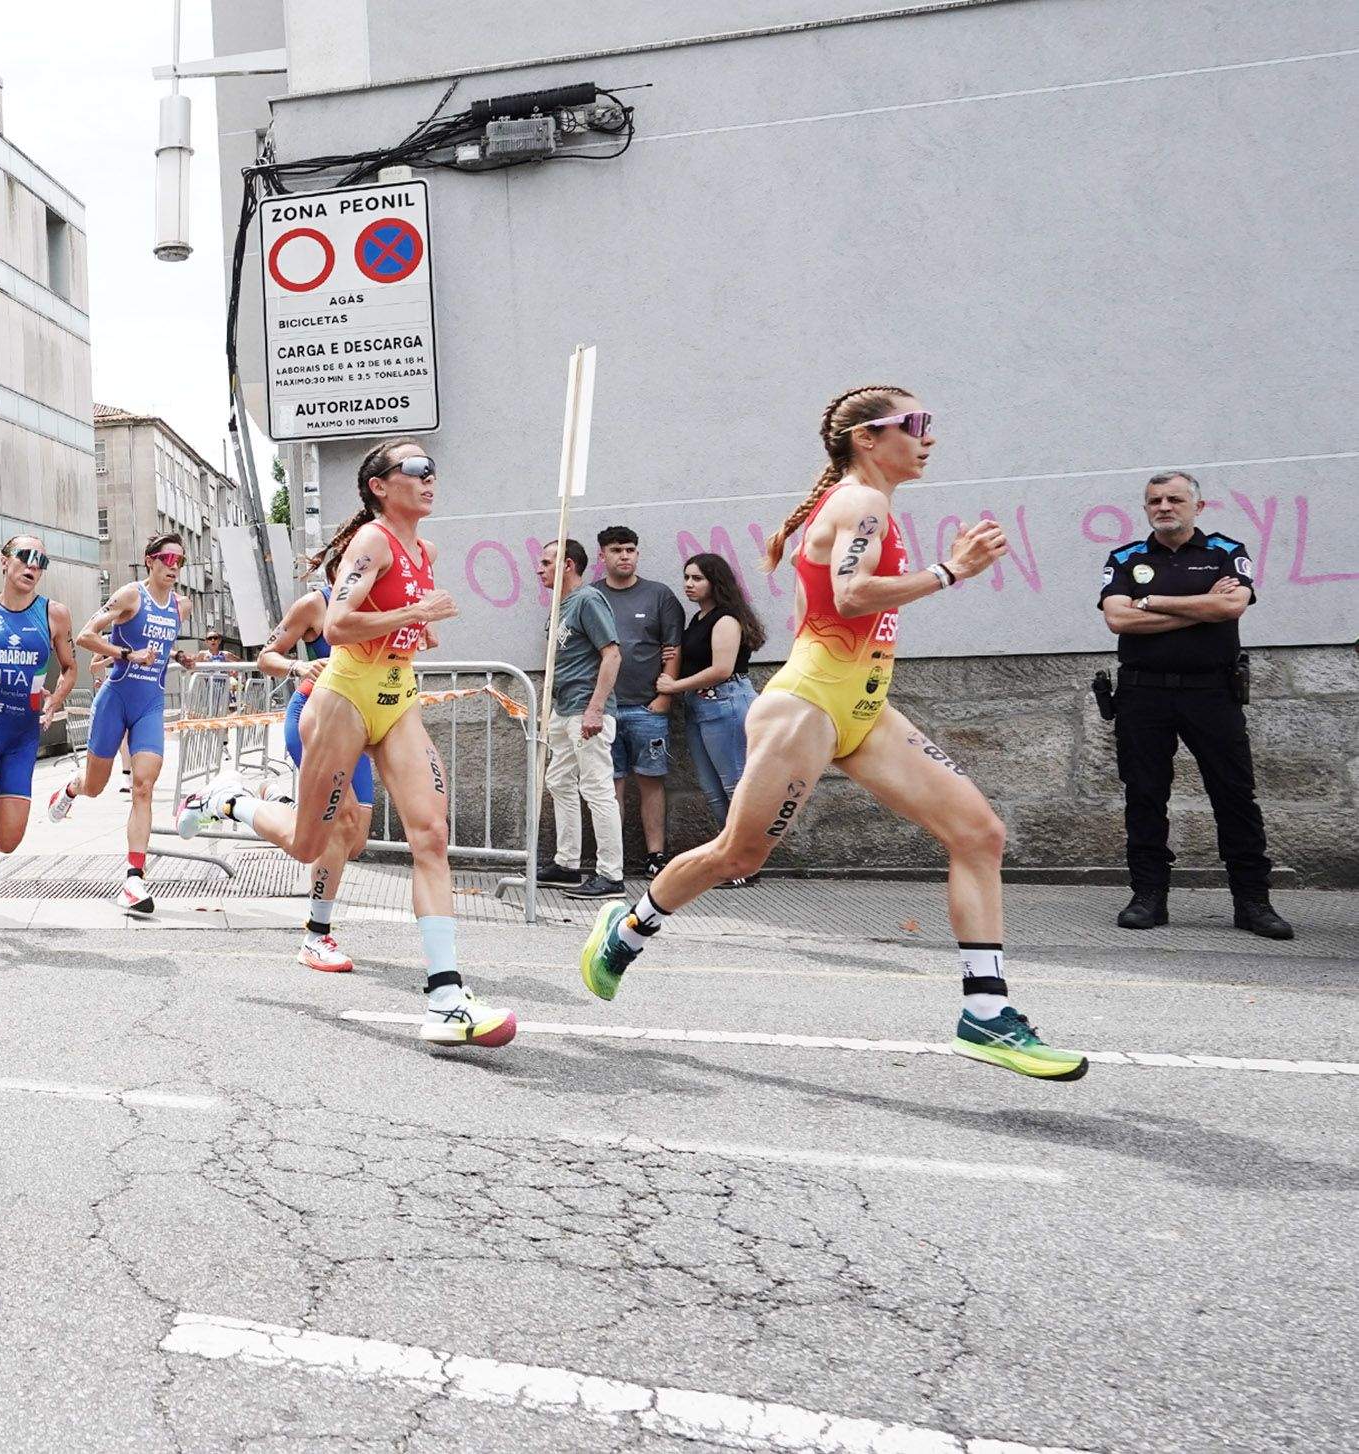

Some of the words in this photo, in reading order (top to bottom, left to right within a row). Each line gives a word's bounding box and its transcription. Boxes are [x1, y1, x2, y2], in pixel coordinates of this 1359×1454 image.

[272, 203, 328, 223] ZONA
[340, 193, 415, 214] PEONIL
[278, 314, 348, 329] BICICLETAS
[277, 344, 326, 359] CARGA
[330, 342, 340, 355] E
[344, 335, 424, 354] DESCARGA
[276, 364, 321, 376] LABORAIS
[323, 363, 335, 372] DE
[356, 360, 366, 368] 12
[368, 359, 380, 368] DE
[348, 374, 355, 382] E
[375, 368, 429, 379] TONELADAS
[295, 396, 411, 417] AUTORIZADOS
[307, 419, 343, 429] MAXIMO
[345, 418, 356, 426] 10
[358, 415, 399, 426] MINUTOS
[837, 537, 869, 576] 82
[143, 624, 176, 641] LEGRAND
[392, 627, 419, 650] ESP
[875, 612, 899, 642] ES
[322, 788, 342, 821] 62
[765, 800, 798, 838] 82
